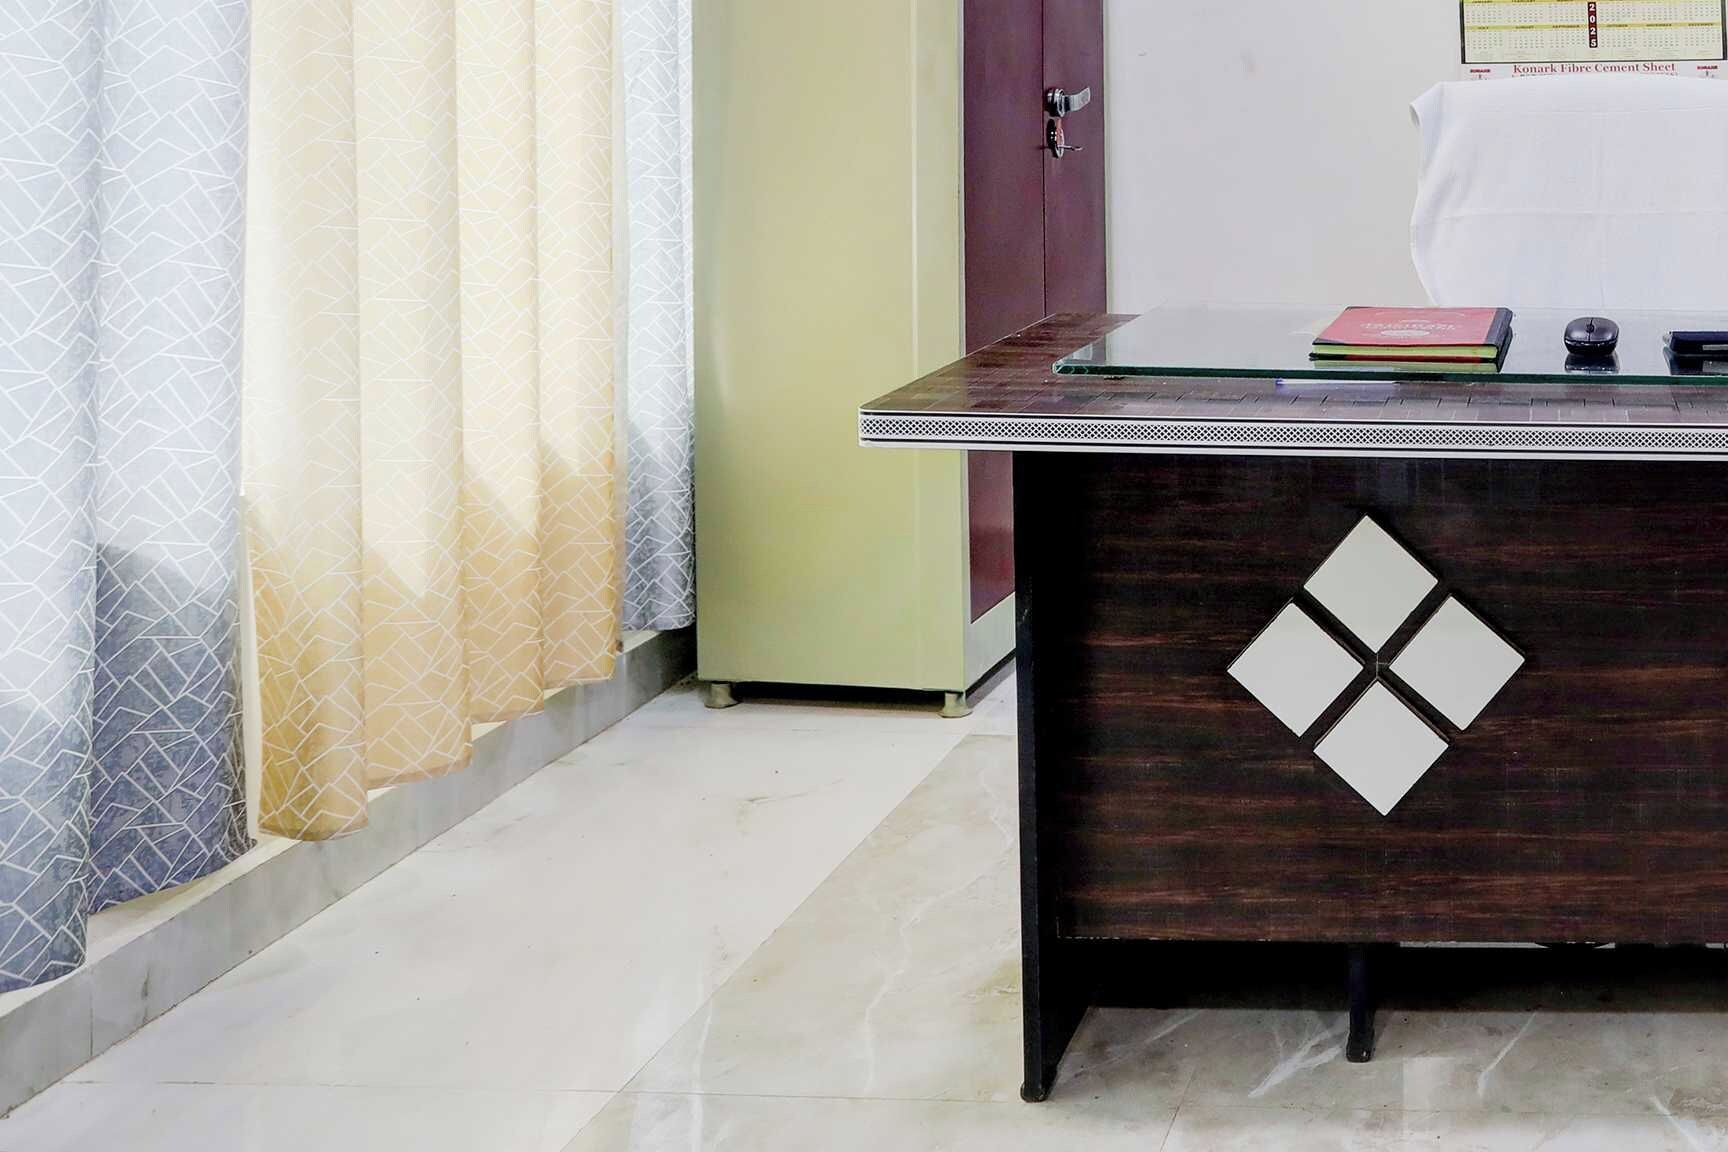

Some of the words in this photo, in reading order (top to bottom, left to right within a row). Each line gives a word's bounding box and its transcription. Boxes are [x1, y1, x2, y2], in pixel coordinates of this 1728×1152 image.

[1513, 64, 1557, 74] Konark
[1561, 63, 1592, 73] Fibre
[1594, 63, 1640, 73] Cement
[1643, 62, 1675, 71] Sheet
